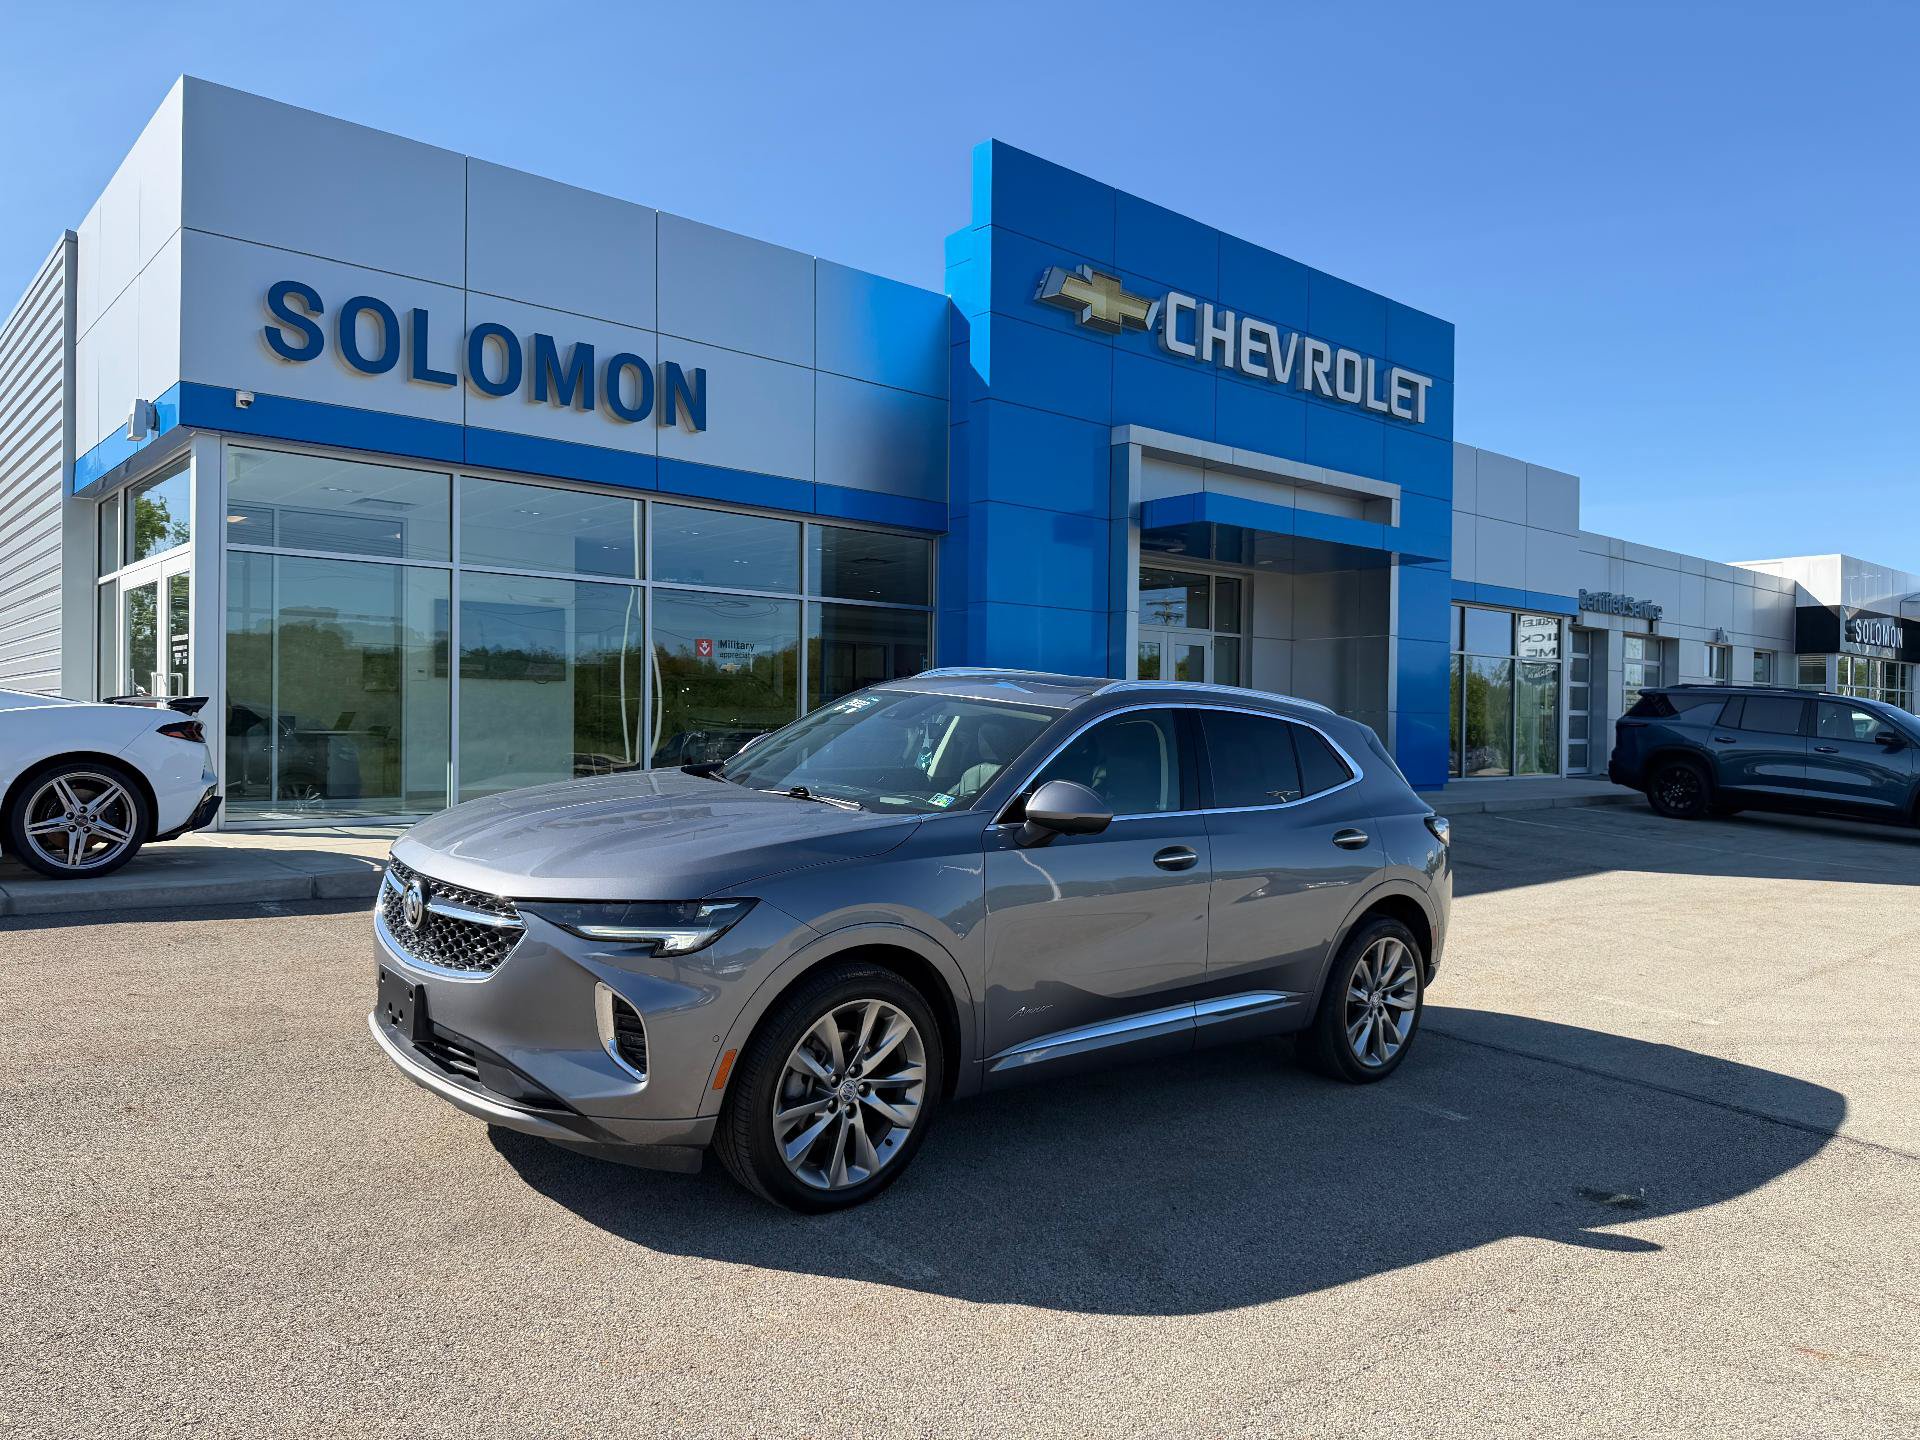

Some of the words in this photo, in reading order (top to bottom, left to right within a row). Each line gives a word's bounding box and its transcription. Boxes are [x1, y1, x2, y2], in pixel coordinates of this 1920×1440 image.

[263, 280, 707, 433] SOLOMON
[1161, 291, 1433, 425] CHEVROLET
[1578, 588, 1625, 615] Certified
[1626, 597, 1663, 620] Service
[718, 639, 755, 652] Military
[1855, 618, 1903, 649] SOLOMON
